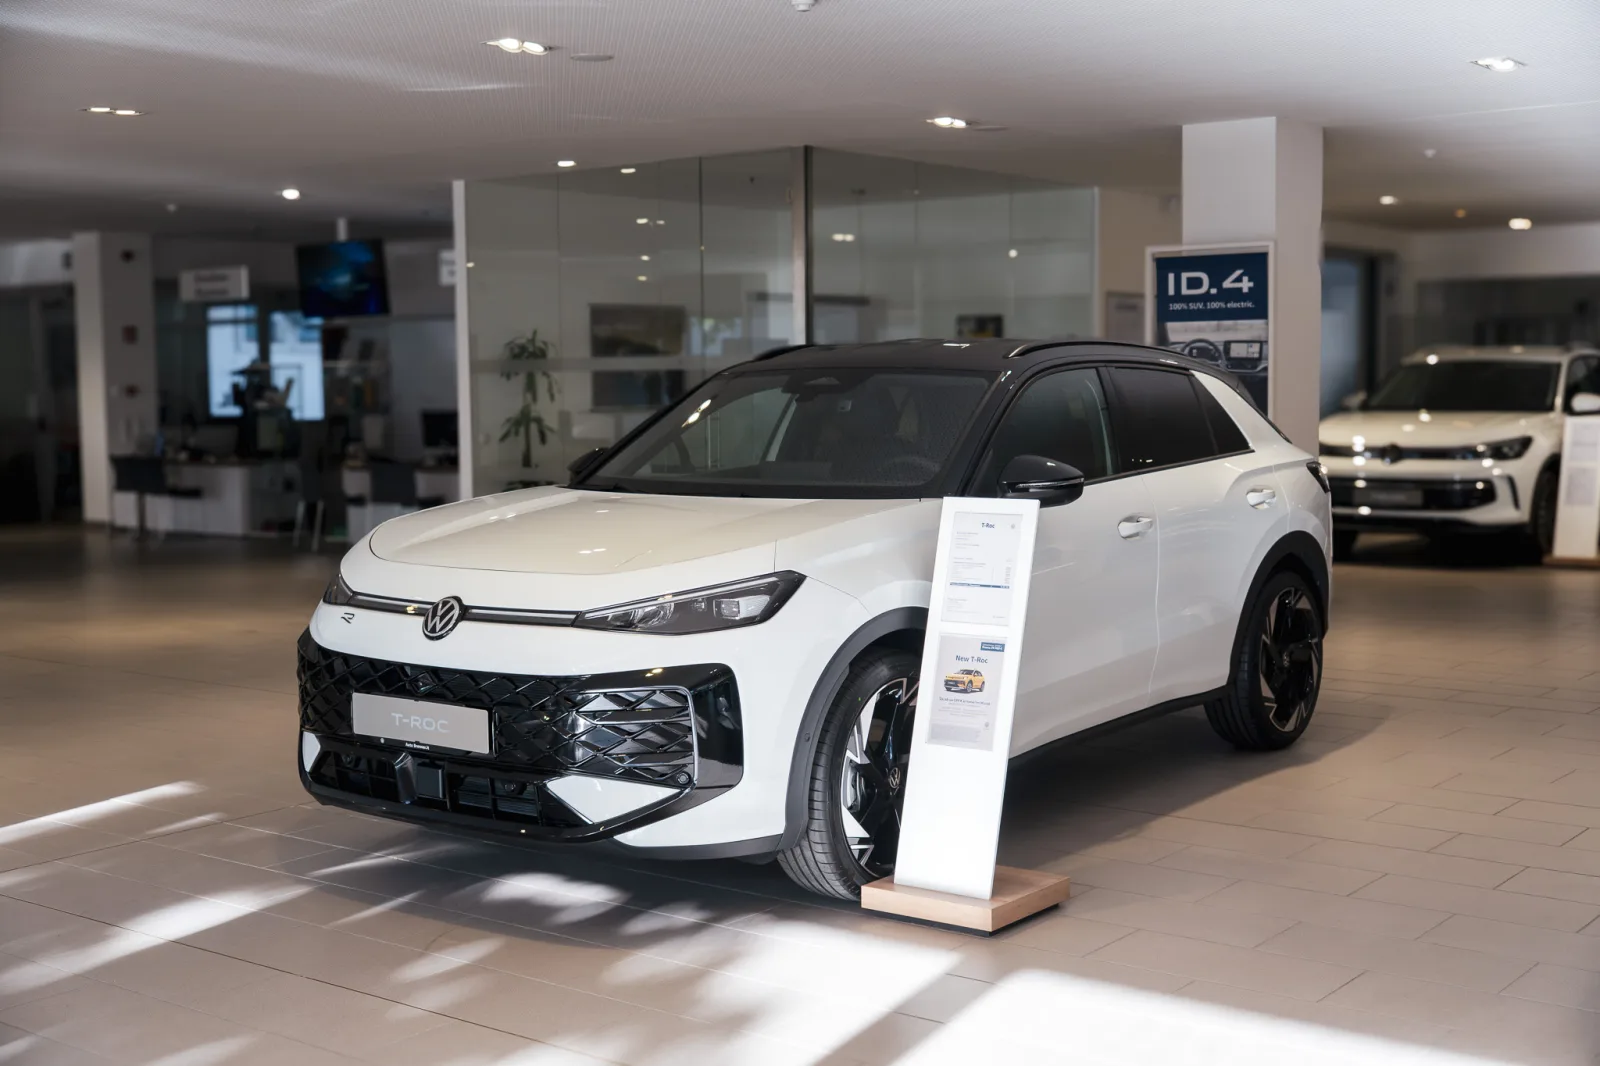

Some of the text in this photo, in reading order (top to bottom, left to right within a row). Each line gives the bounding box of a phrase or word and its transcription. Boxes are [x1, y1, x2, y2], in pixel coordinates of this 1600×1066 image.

[1168, 269, 1254, 296] ID.4
[1189, 302, 1205, 310] SUV.
[955, 655, 989, 664] New T-Roc
[392, 713, 449, 732] T-ROC
